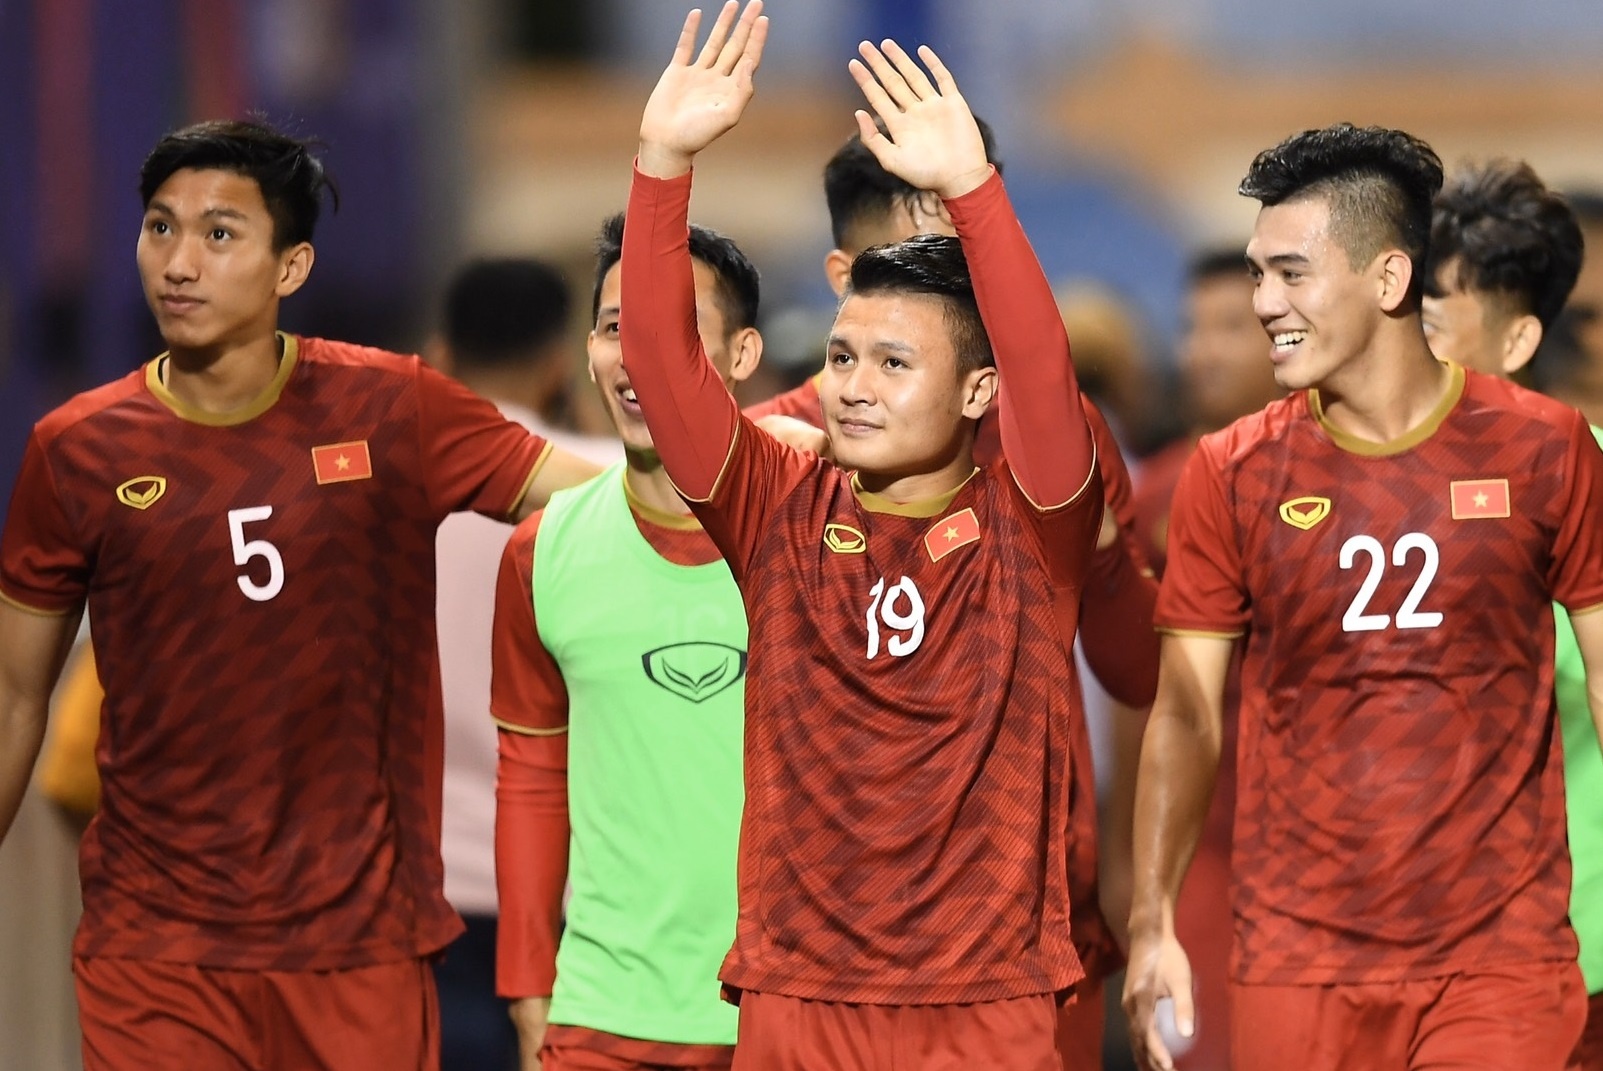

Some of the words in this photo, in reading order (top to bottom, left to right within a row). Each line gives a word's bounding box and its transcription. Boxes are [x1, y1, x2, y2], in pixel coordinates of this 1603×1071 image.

[228, 505, 285, 601] 5
[1339, 532, 1444, 632] 22
[866, 576, 926, 660] 19
